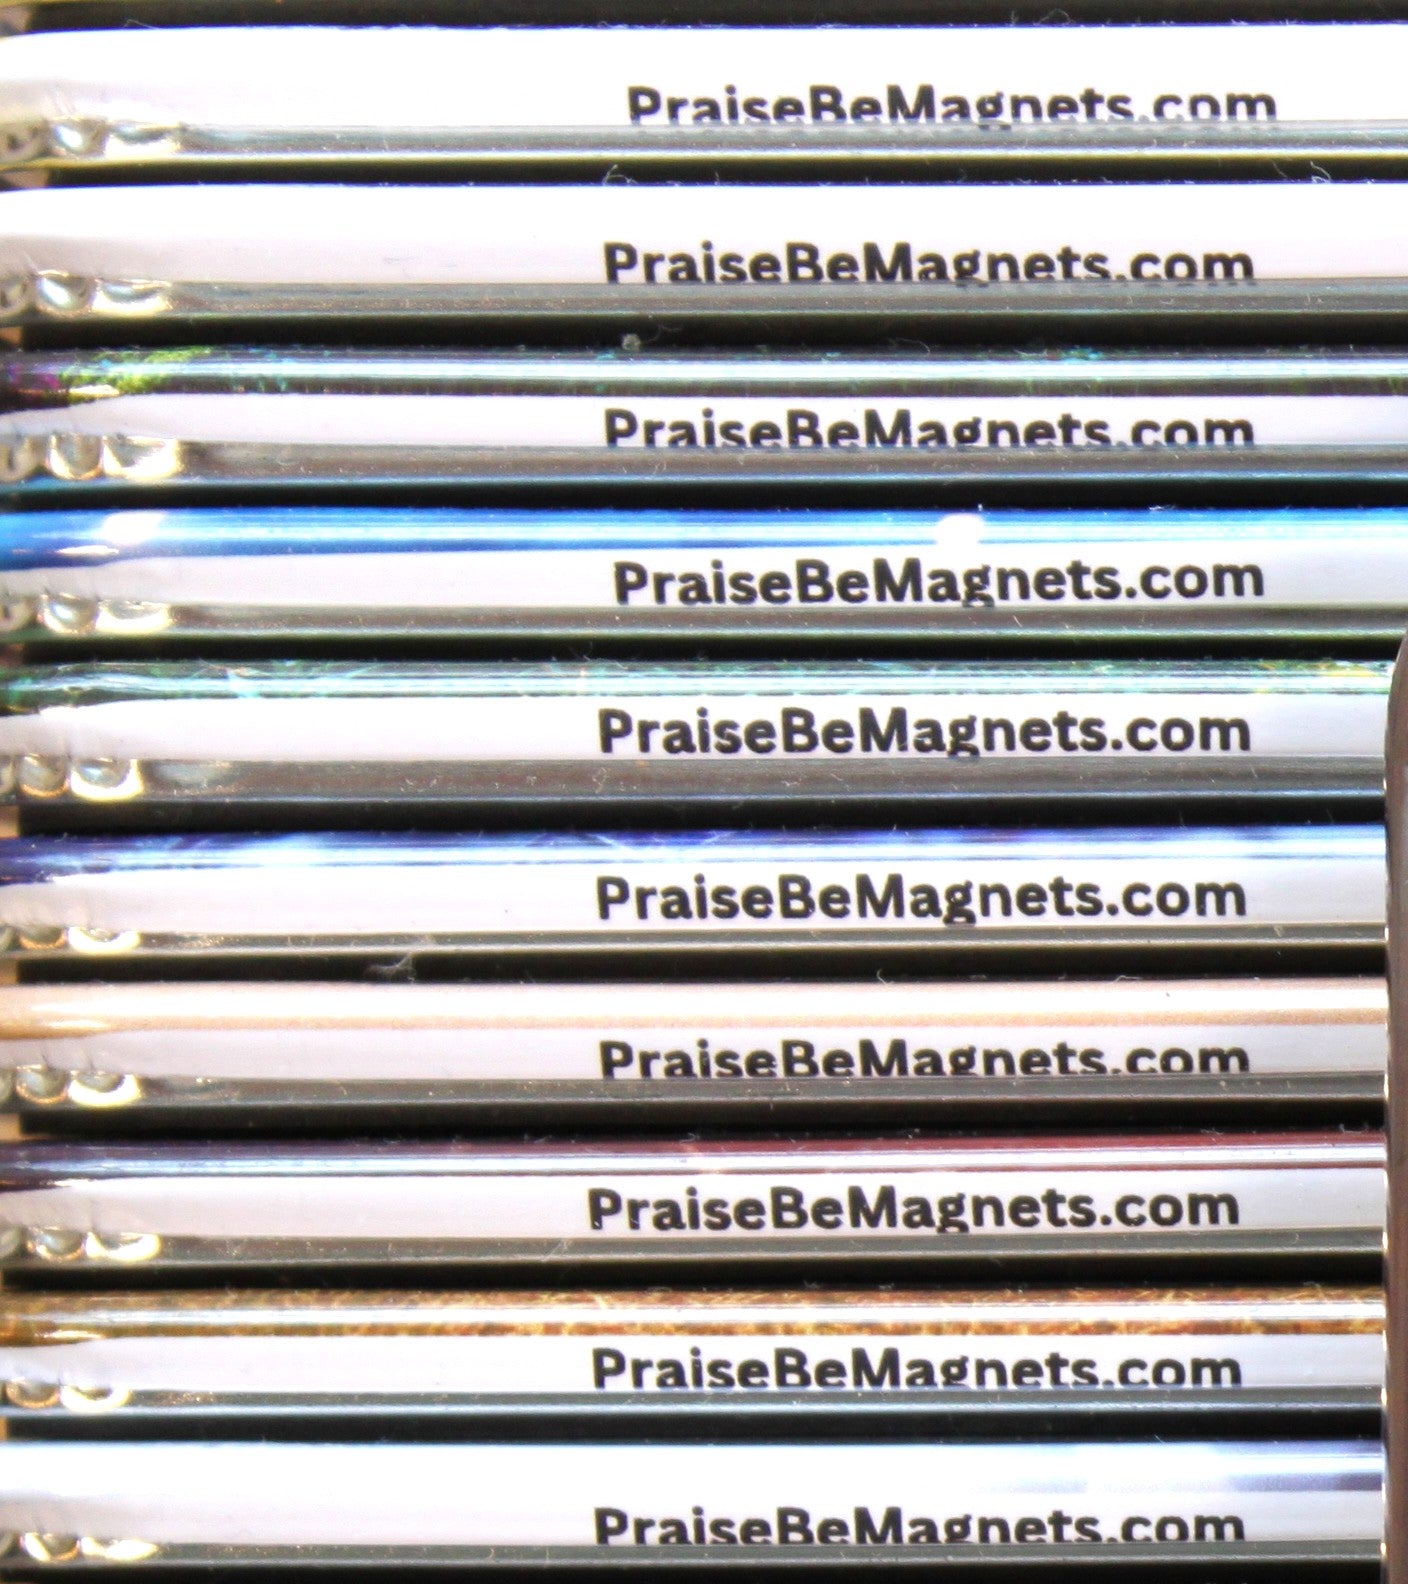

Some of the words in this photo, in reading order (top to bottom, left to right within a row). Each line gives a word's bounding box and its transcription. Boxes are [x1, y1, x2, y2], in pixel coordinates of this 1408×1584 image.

[604, 241, 1254, 285] PraiseBeMagnets.com
[605, 408, 1254, 448] PraiseBeMagnets.com
[613, 559, 1265, 607] PraiseBeMagnets.com
[598, 707, 1251, 757] PraiseBeMagnets.com
[596, 874, 1247, 925] PraiseBeMagnets.com
[600, 1039, 1250, 1079] PraiseBeMagnets.com
[587, 1186, 1240, 1233] PraiseBeMagnets.com
[592, 1346, 1242, 1389] PraiseBeMagnets.com
[594, 1506, 1245, 1545] PraiseBeMagnets.com
